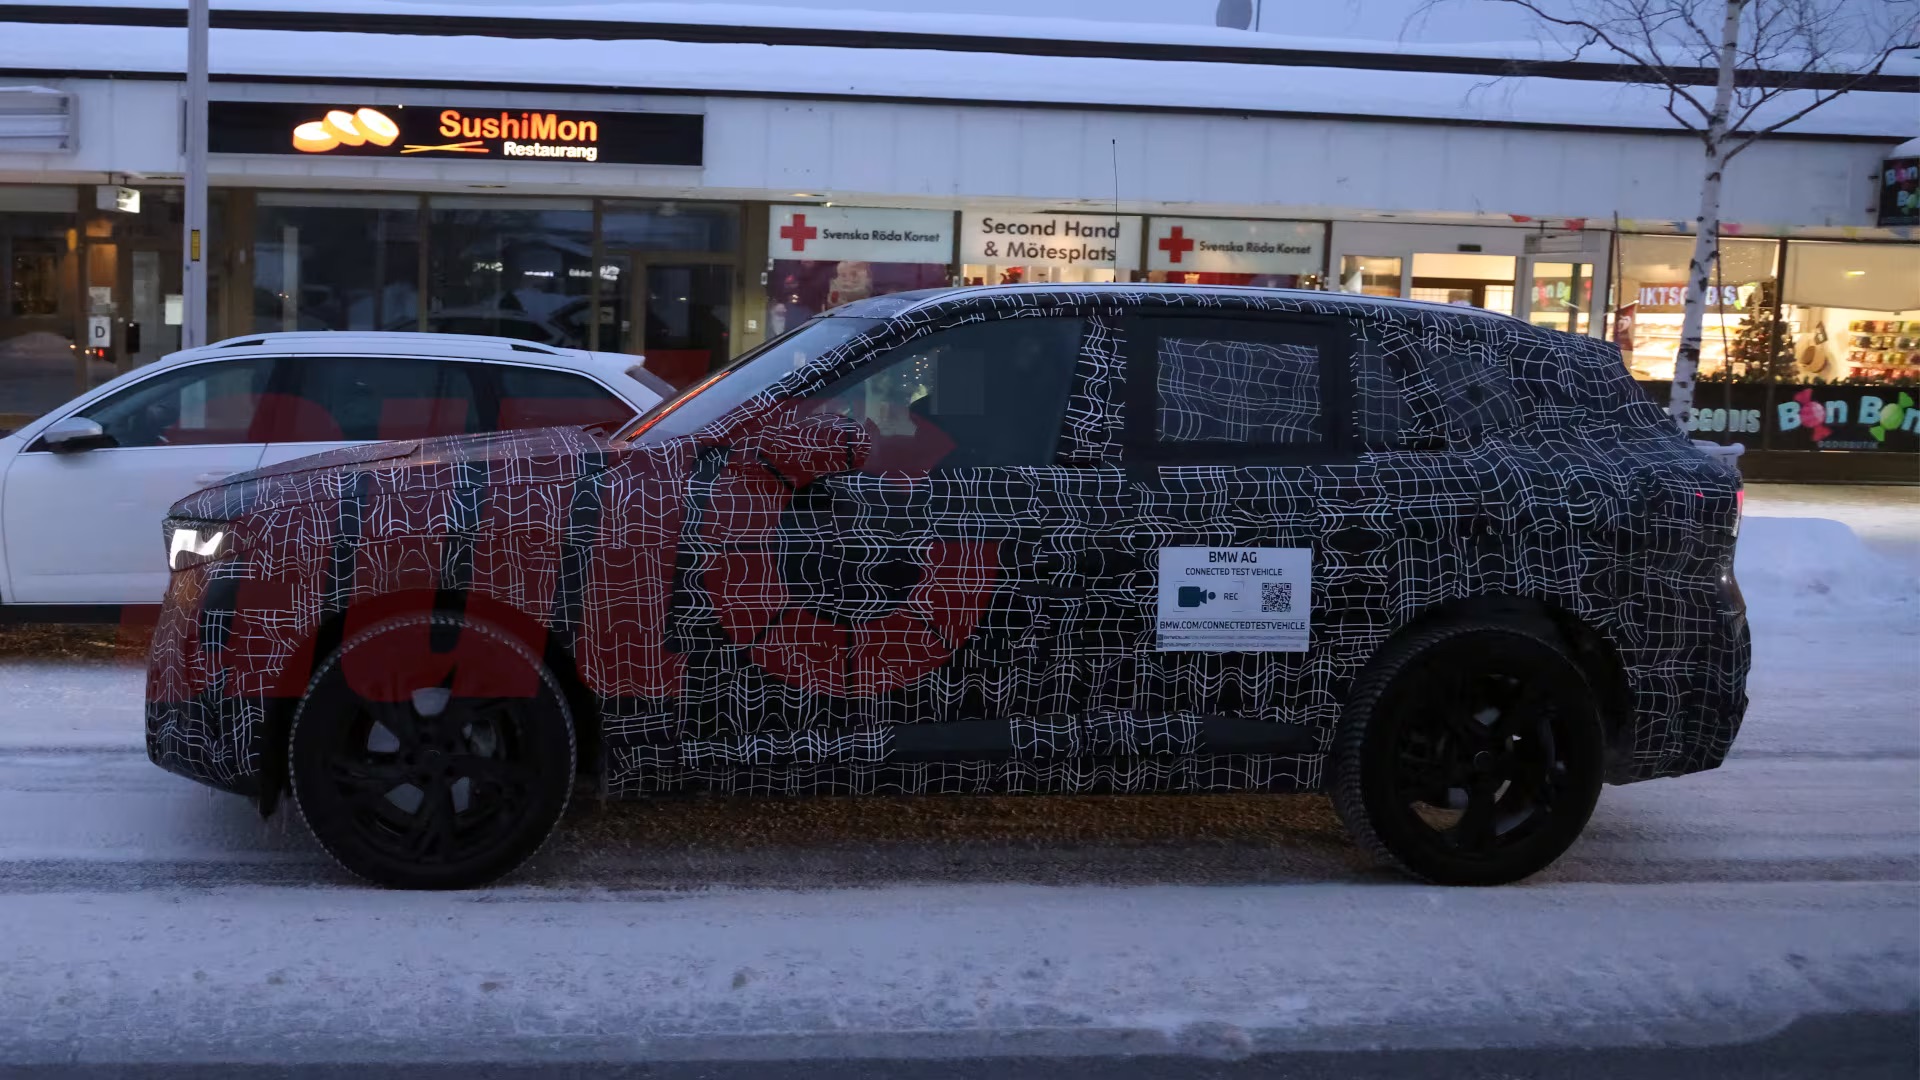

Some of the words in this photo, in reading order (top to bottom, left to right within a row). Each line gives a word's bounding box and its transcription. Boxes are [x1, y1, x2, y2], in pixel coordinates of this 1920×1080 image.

[439, 109, 598, 142] SushiMon
[503, 140, 598, 162] Restaurang
[982, 217, 1056, 236] Second
[1065, 220, 1120, 239] Hand
[822, 228, 869, 241] Svenska
[872, 229, 902, 242] Röda
[903, 230, 940, 243] Korset
[984, 240, 999, 257] &
[1006, 241, 1117, 264] Mötesplats
[1199, 240, 1244, 253] Svenska
[1246, 241, 1274, 254] Röda
[1277, 242, 1311, 254] Korset
[95, 325, 106, 338] D
[1208, 551, 1238, 563] BMW
[1241, 551, 1258, 563] AG
[1185, 567, 1230, 576] CONNECTED
[1231, 567, 1250, 576] TEST
[1251, 567, 1283, 576] VEHICLE
[1223, 592, 1239, 601] REC
[1159, 620, 1306, 631] BMW.COM/CONNECTEDTESTVEHICLE
